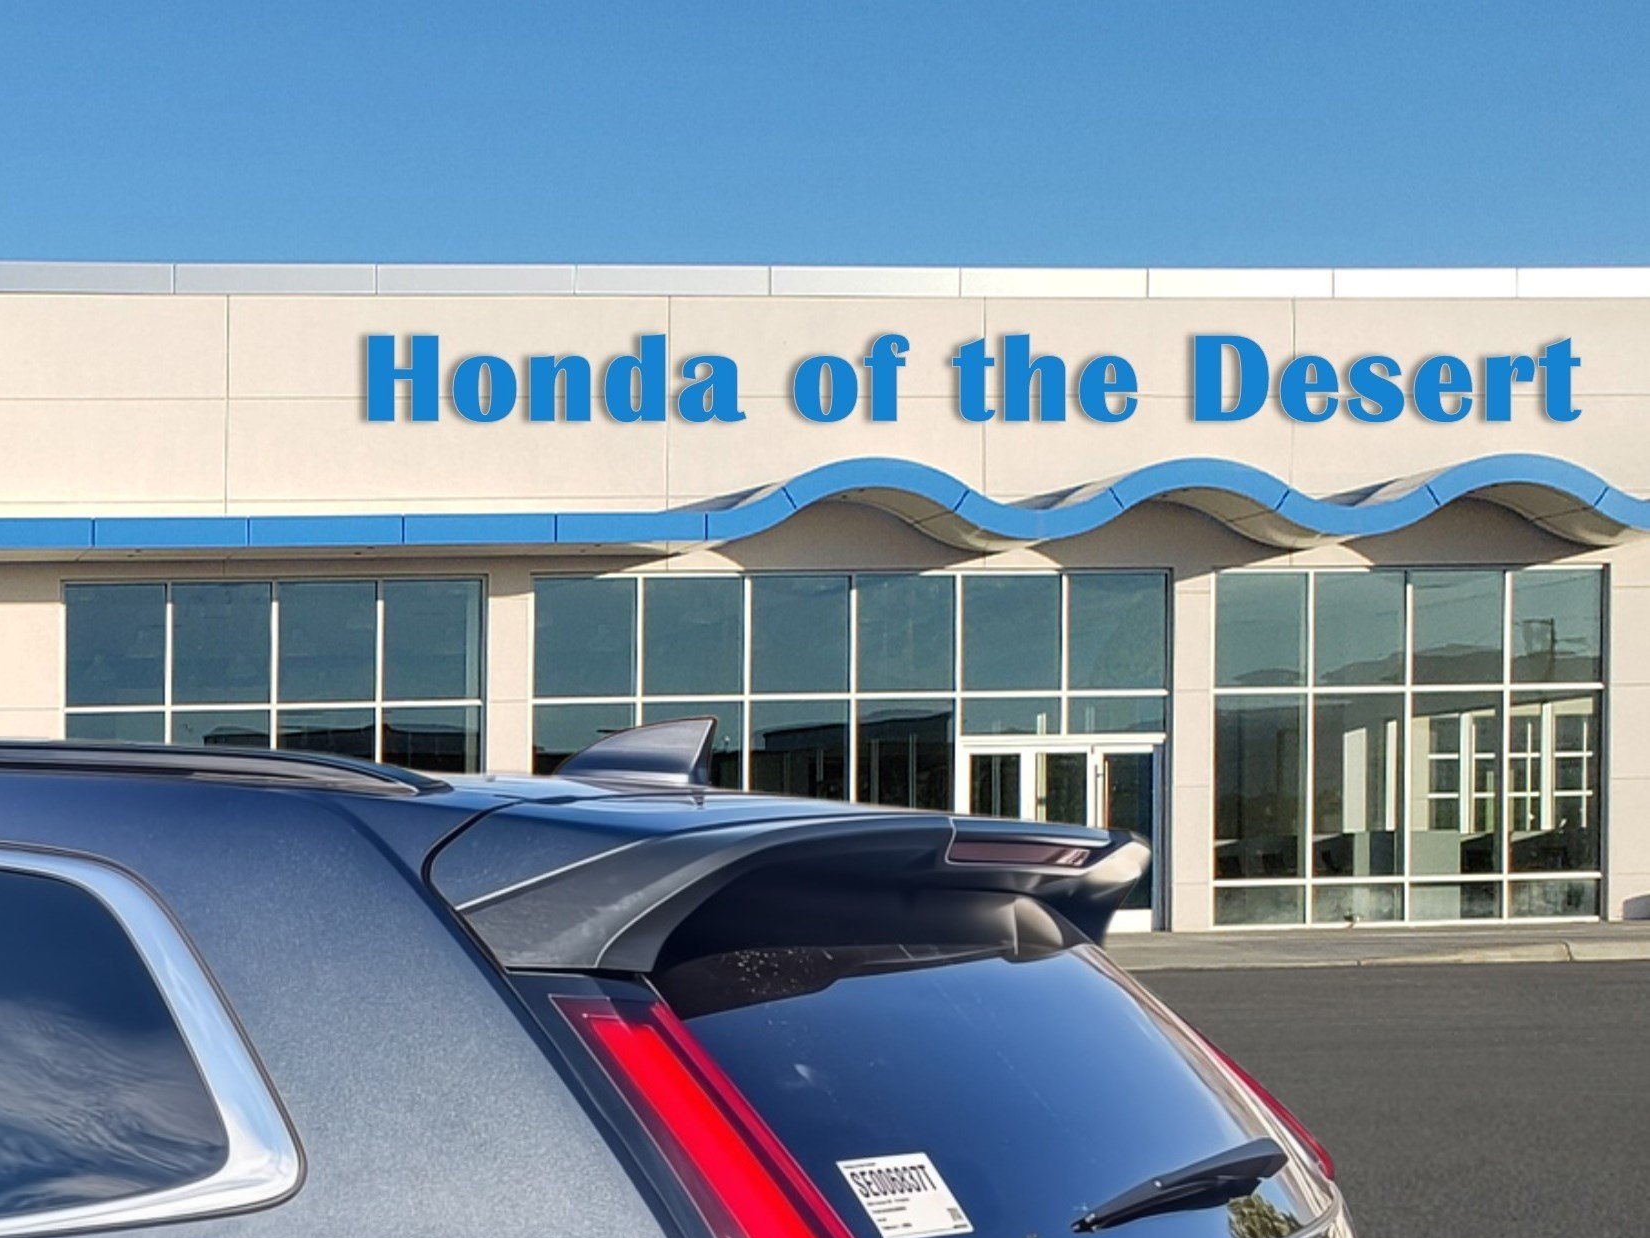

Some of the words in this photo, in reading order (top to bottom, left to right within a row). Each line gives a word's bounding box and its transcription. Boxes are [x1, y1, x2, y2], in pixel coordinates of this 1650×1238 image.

[364, 333, 747, 424] Honda
[792, 333, 910, 424] of
[951, 333, 1140, 424] the
[1191, 333, 1583, 424] Desert
